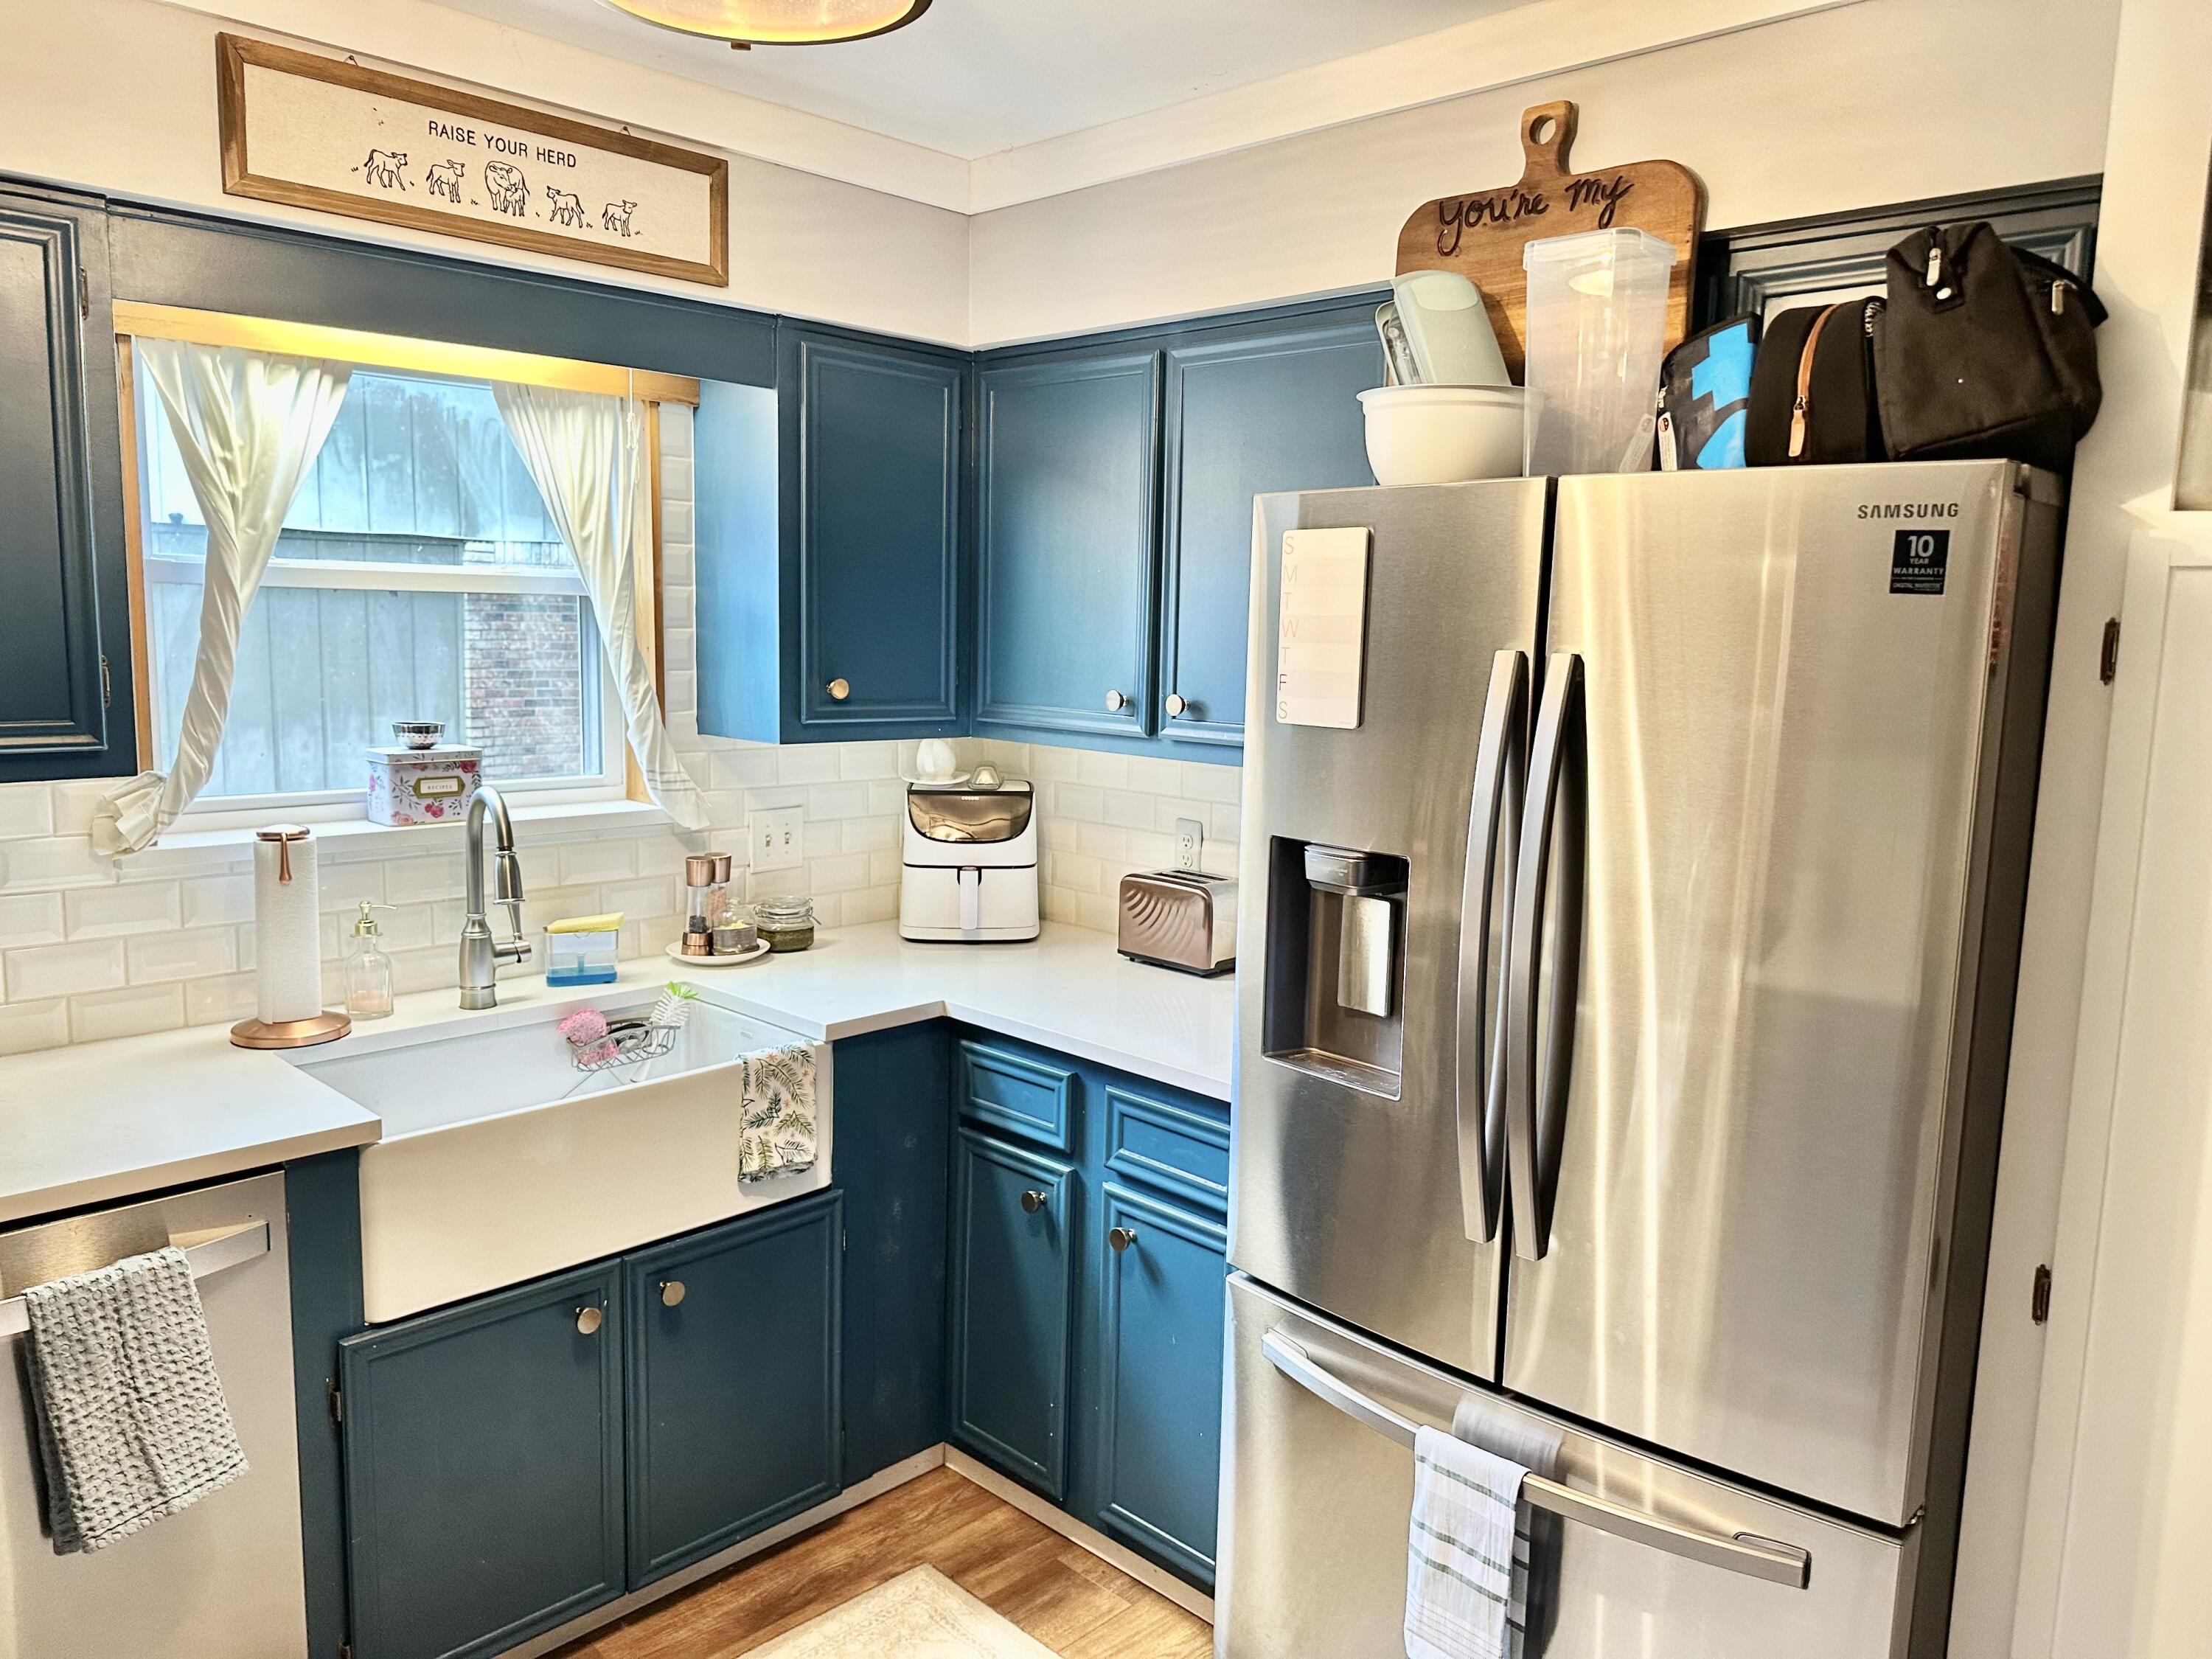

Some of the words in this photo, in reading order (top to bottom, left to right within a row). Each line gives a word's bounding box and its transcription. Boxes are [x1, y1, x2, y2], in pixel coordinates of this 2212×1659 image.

[428, 120, 476, 146] RAISE
[484, 133, 528, 158] YOUR
[536, 147, 577, 168] HERD
[1857, 503, 1959, 519] SAMSUNG
[1284, 535, 1294, 554] S
[1907, 535, 1935, 557] 10
[1282, 564, 1298, 583] M
[1893, 567, 1944, 575] WARRANTY
[1282, 591, 1293, 611] T
[1281, 619, 1299, 638] W
[1280, 647, 1291, 665] T
[1279, 673, 1287, 692] F
[1278, 701, 1287, 720] S
